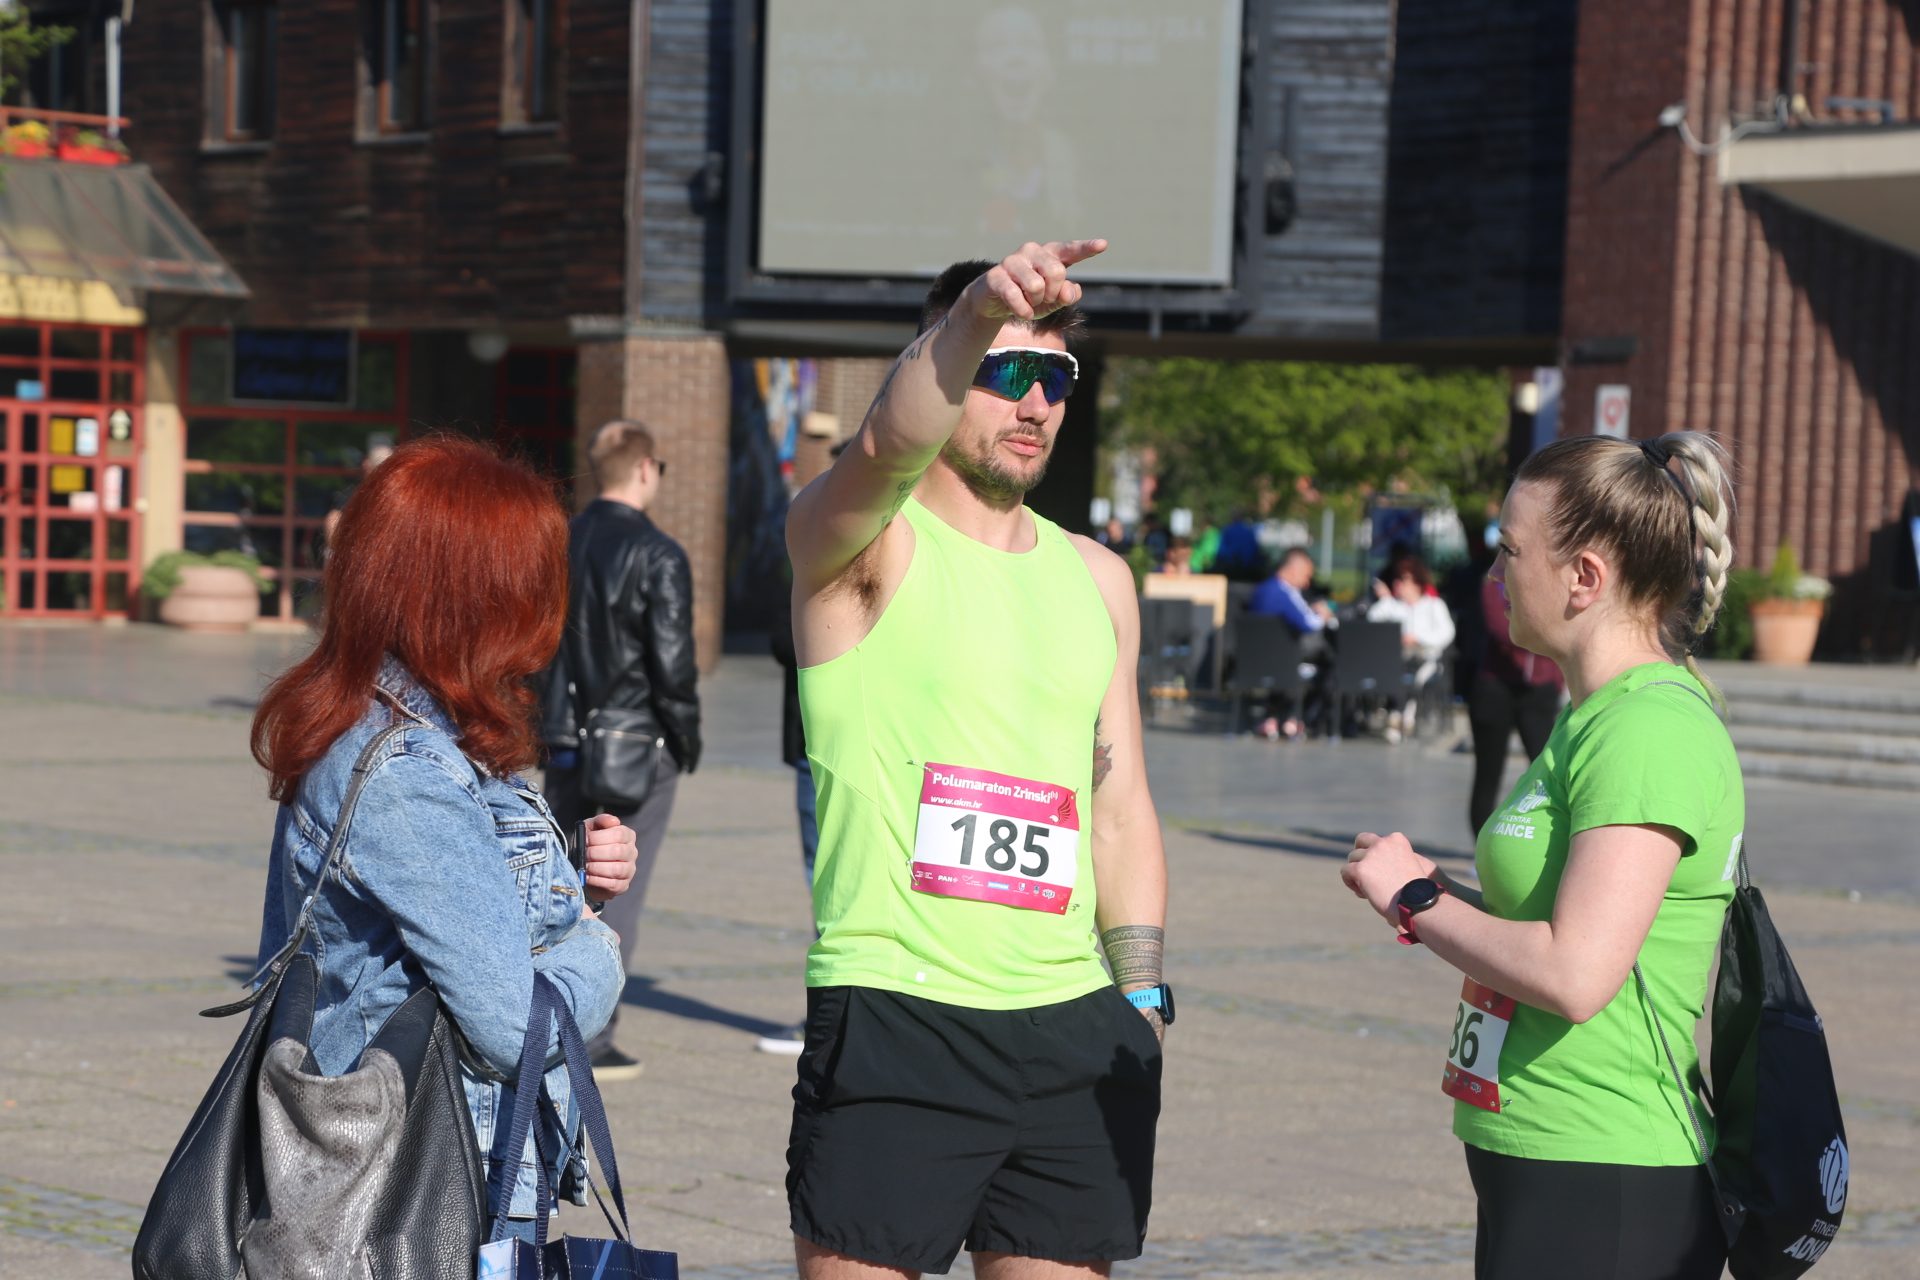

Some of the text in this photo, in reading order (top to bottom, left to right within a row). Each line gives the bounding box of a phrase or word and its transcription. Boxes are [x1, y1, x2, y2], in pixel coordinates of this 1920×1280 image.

[930, 796, 983, 809] www.akm.hr
[932, 772, 1051, 804] Polumaraton Zrinski
[950, 813, 1050, 878] 185
